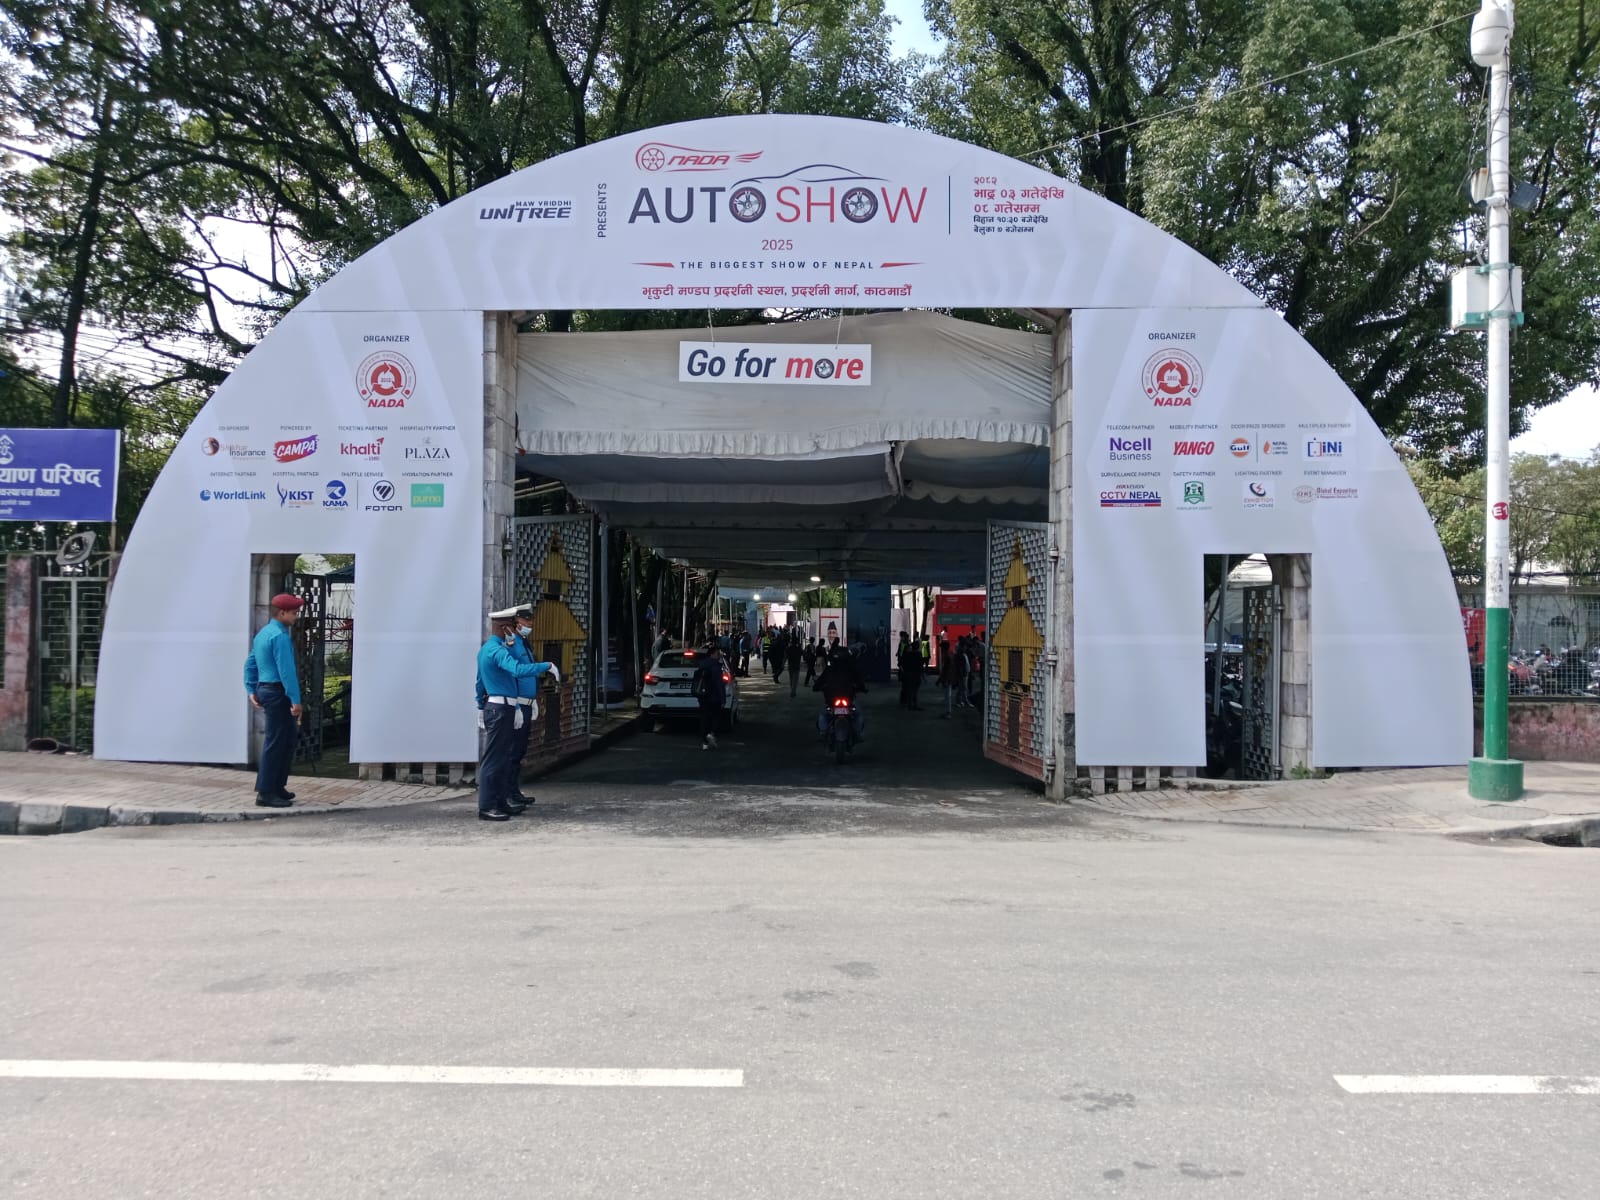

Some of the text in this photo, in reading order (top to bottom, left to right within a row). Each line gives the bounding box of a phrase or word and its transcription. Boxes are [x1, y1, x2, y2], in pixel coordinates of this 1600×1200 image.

[667, 155, 731, 166] NADA
[974, 187, 1064, 200] भाद्र ०३ गतेदेखि
[597, 182, 608, 239] PRESENTS
[627, 185, 928, 224] AUTO SHOW
[994, 201, 1040, 214] गतेसम्म
[479, 204, 572, 223] UNITREE
[762, 239, 793, 251] 2025
[680, 261, 874, 269] THE BIGGEST SHOW OF NEPAL
[678, 285, 710, 296] मण्डप
[714, 283, 753, 297] प्रदर्शनी
[757, 284, 787, 297] स्थल,
[791, 283, 831, 298] प्रदर्शनी
[1148, 332, 1196, 340] ORGANIZER
[687, 348, 864, 380] Go for more
[367, 399, 405, 408] NADA
[1154, 397, 1191, 406] NADA
[276, 440, 316, 457] CAMPA
[340, 442, 381, 455] khalti
[1109, 437, 1151, 451] Ncell
[1173, 441, 1215, 456] YANGO
[229, 446, 266, 456] Insurance
[405, 447, 451, 459] PLAZA
[1109, 452, 1152, 461] Business
[0, 467, 38, 484] याण
[213, 490, 266, 501] WorldLink
[288, 490, 315, 501] KIST
[1100, 491, 1161, 499] CCTV NEPAL
